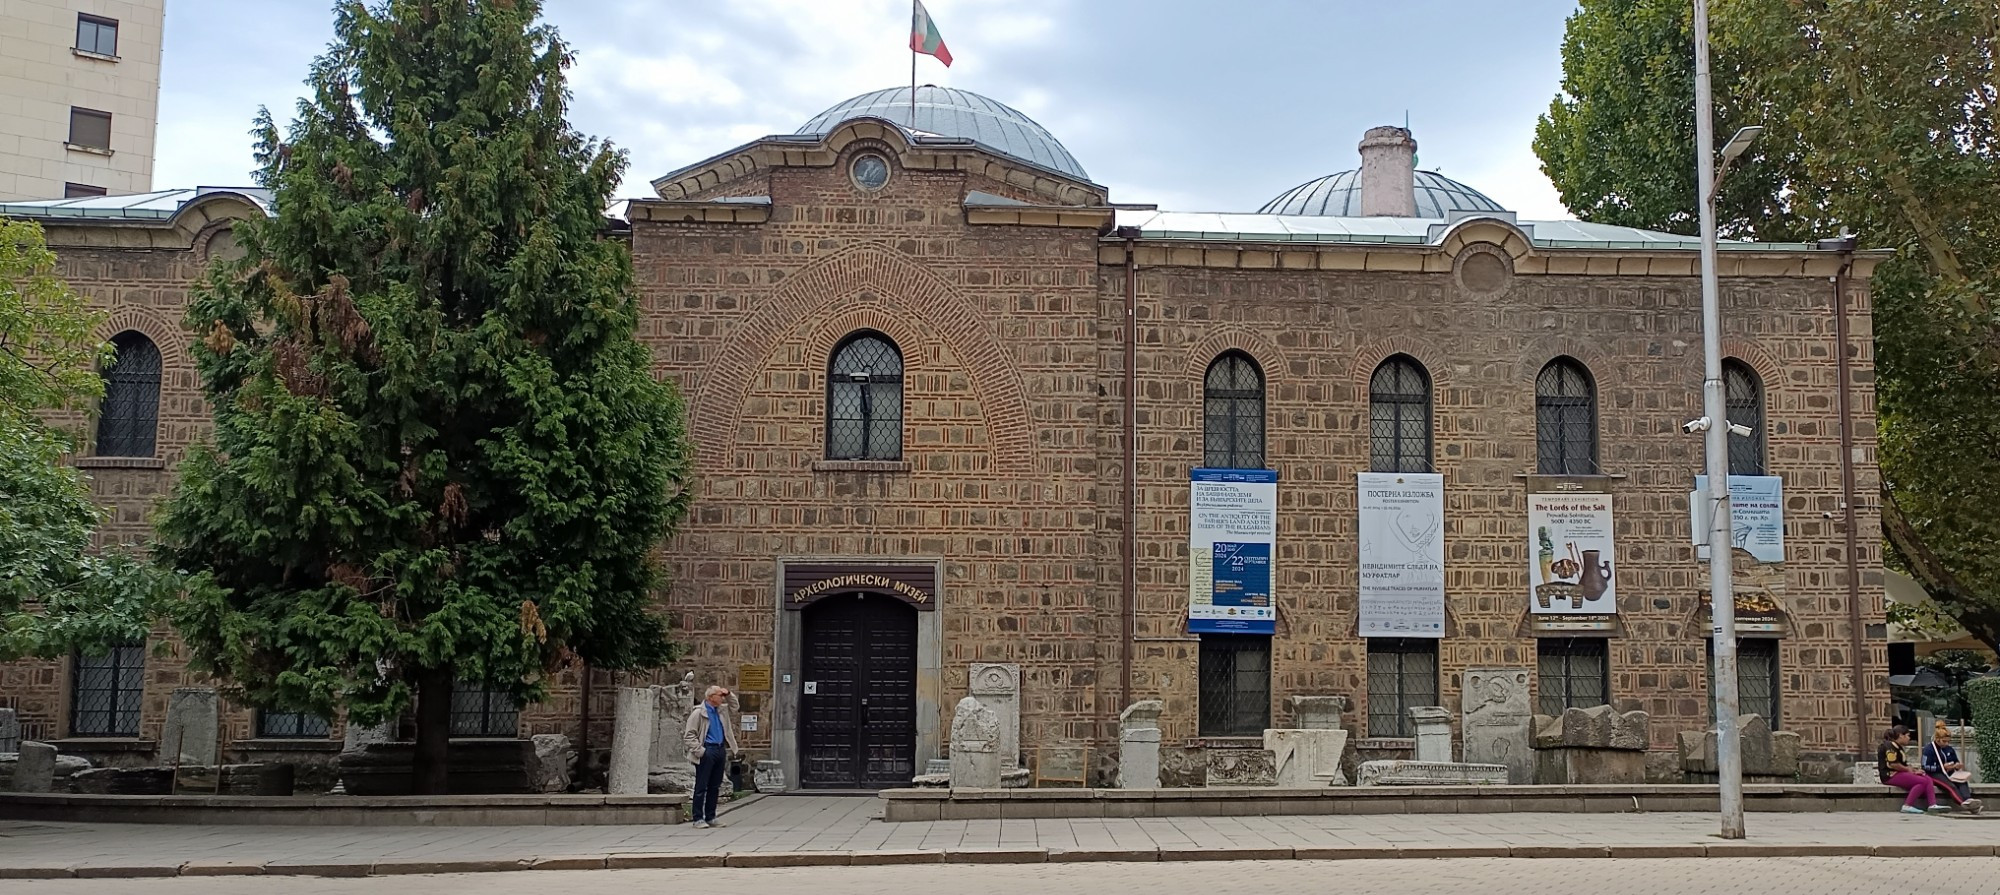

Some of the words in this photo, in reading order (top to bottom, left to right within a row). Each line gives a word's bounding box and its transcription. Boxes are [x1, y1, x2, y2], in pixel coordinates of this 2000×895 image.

[1367, 490, 1401, 498] ПОСТЕРНА
[1402, 491, 1434, 499] ИЗЛОЖБА
[1214, 543, 1227, 553] 20
[1231, 556, 1244, 566] 22
[793, 574, 890, 603] АРХЕОЛОГИЧЕСКИ
[893, 580, 928, 604] МУЗЕЙ
